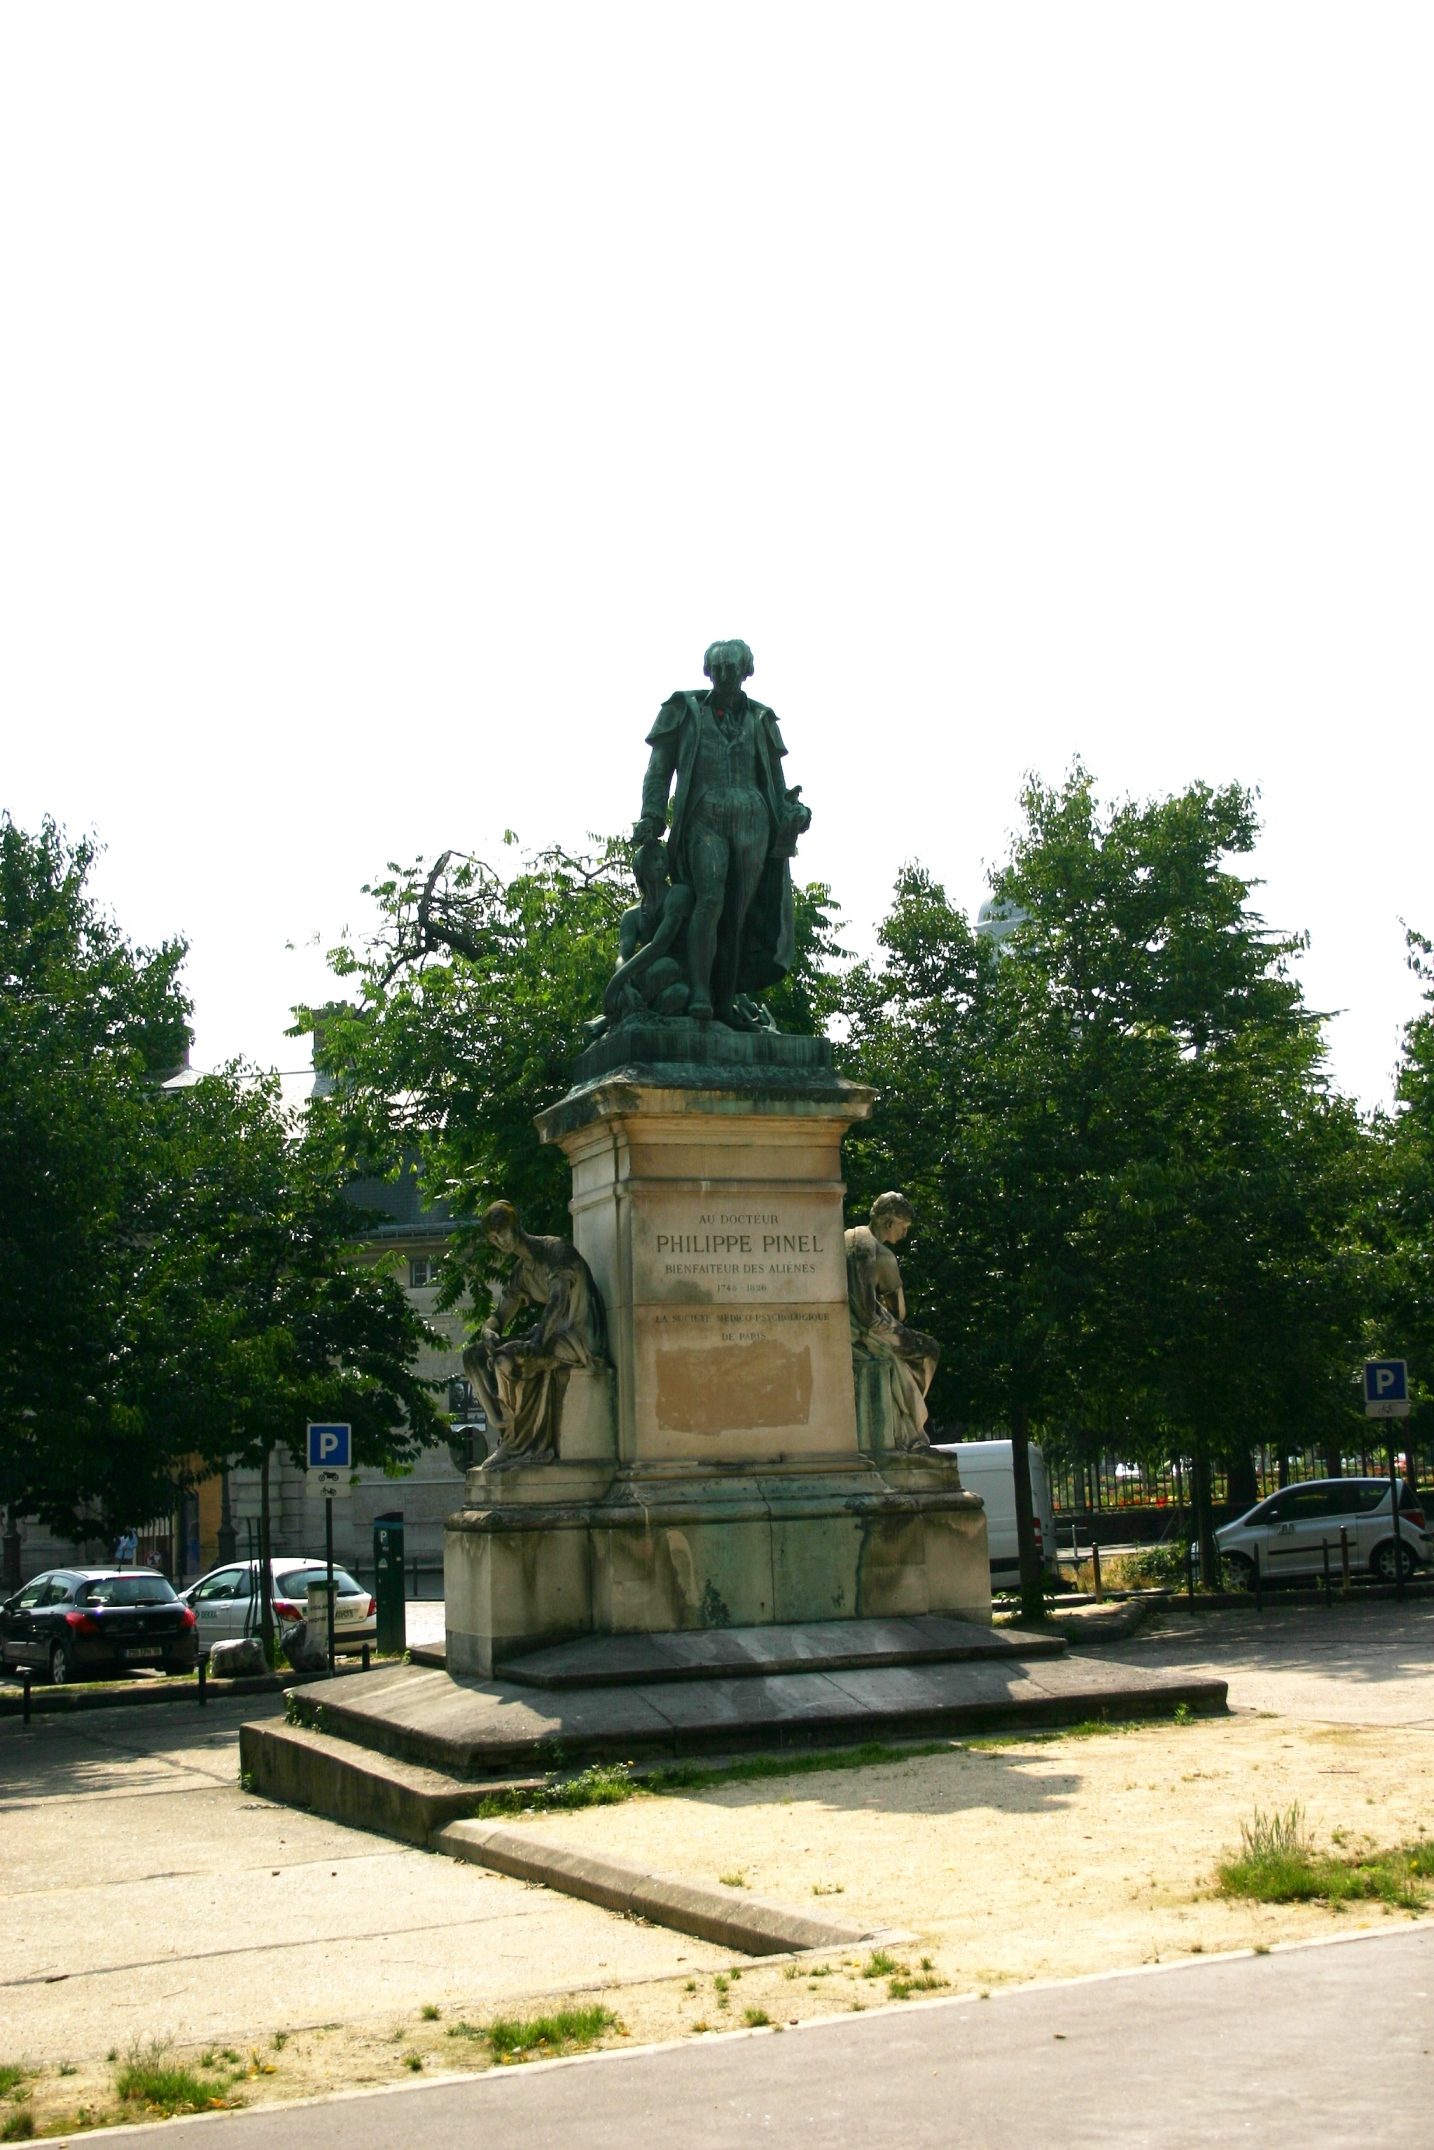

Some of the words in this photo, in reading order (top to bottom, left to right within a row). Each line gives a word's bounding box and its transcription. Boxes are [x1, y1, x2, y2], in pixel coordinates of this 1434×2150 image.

[699, 1214, 715, 1224] AU
[720, 1214, 779, 1225] DOCTEUR
[656, 1234, 753, 1253] PHILIPPE
[763, 1234, 824, 1253] PINEL
[665, 1263, 739, 1274] BIENFAITEUR
[743, 1263, 765, 1274] DES
[721, 1332, 735, 1341] DE
[739, 1331, 767, 1341] PARIS
[1375, 1368, 1395, 1395] P
[319, 1432, 339, 1460] P
[380, 1530, 387, 1544] P
